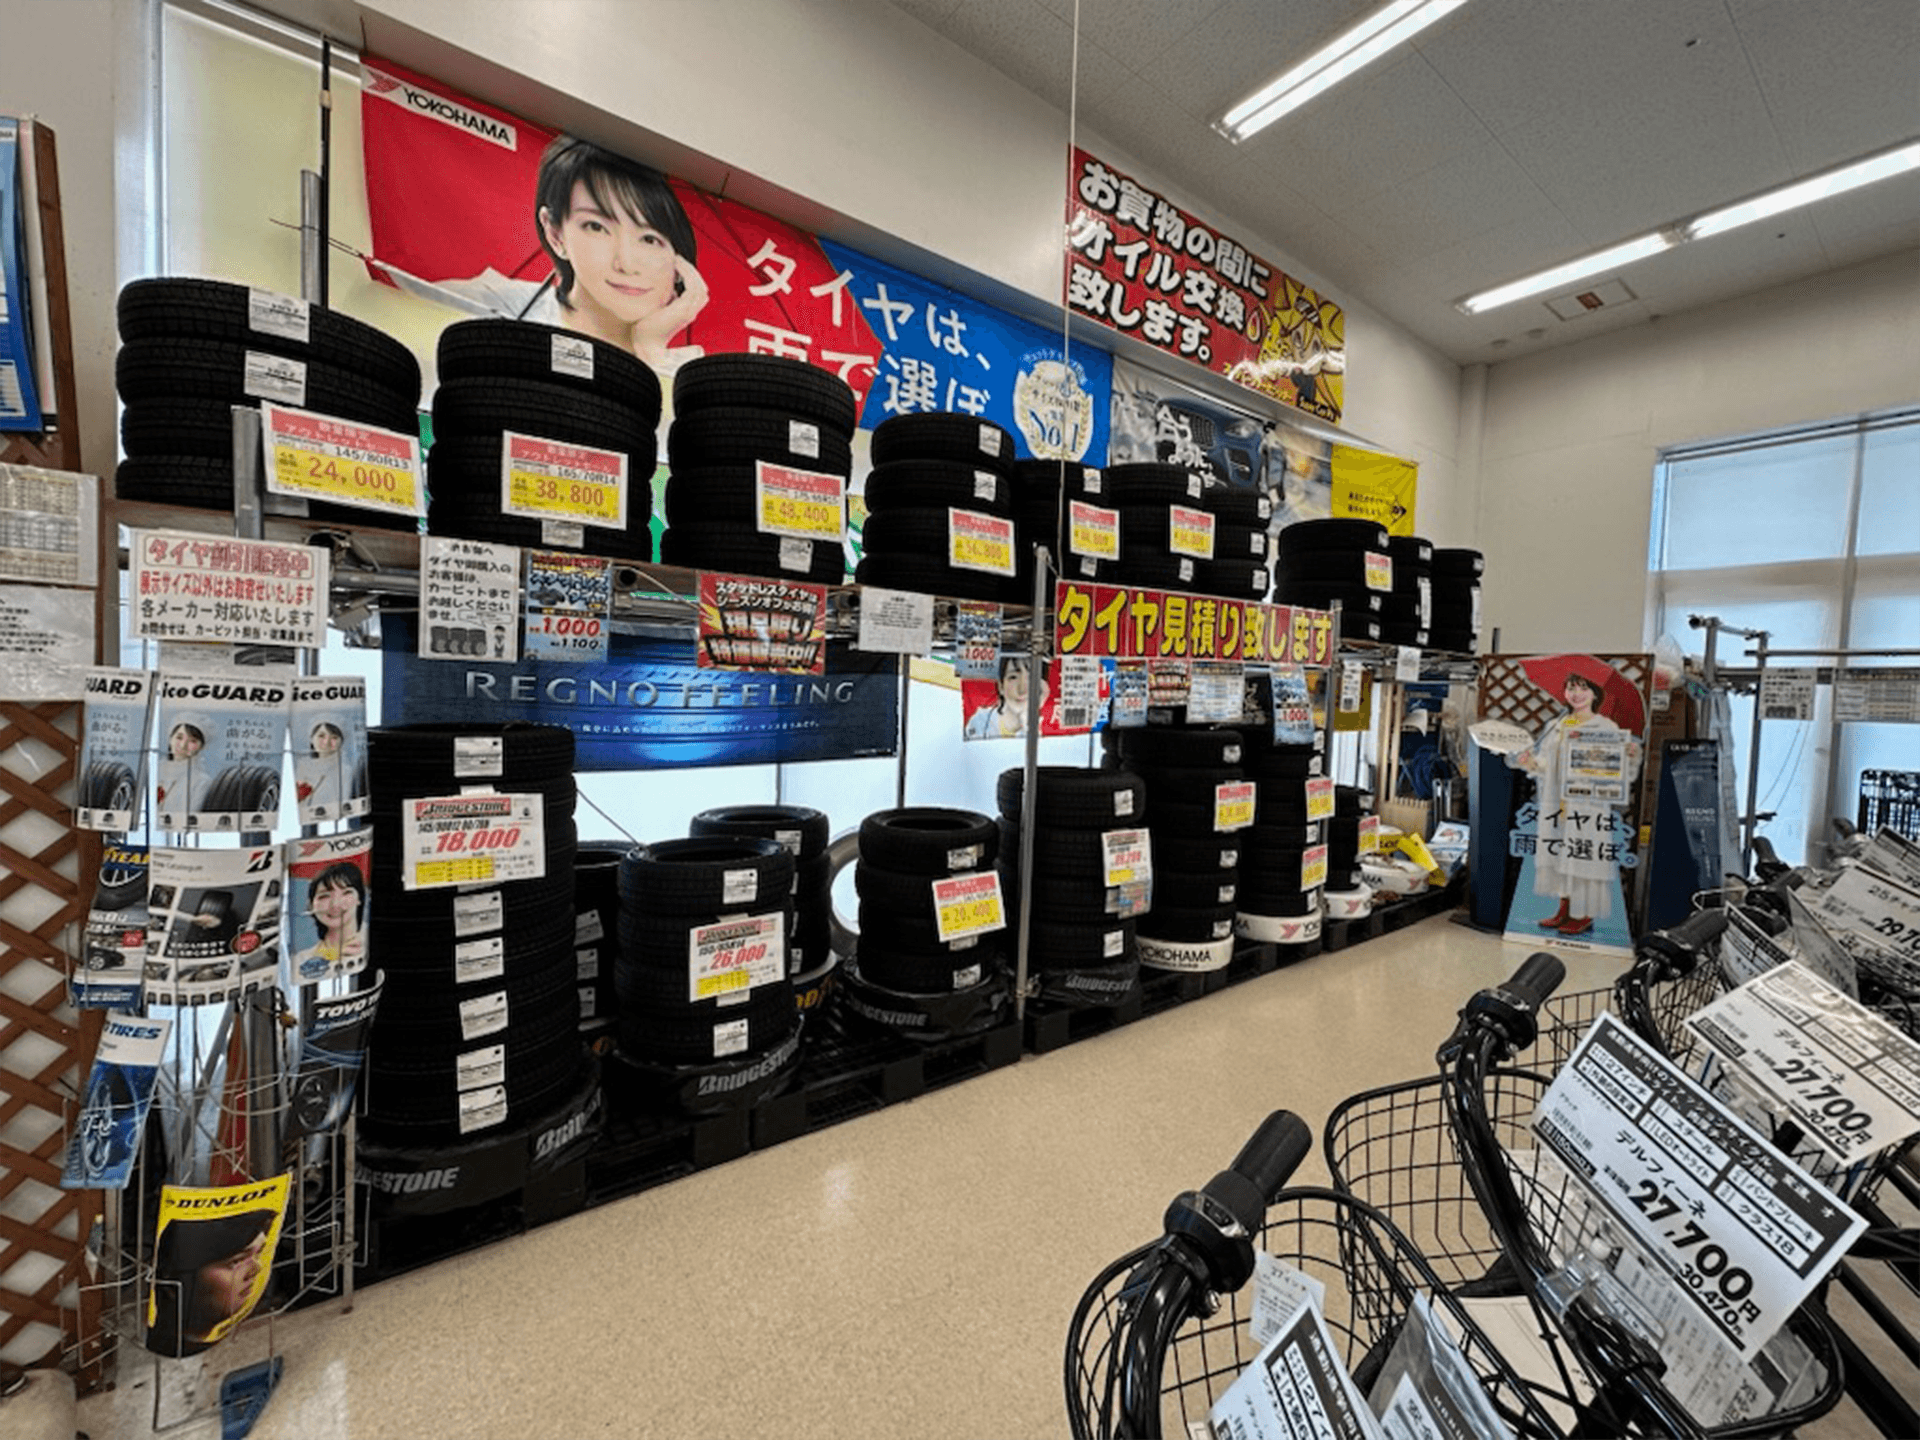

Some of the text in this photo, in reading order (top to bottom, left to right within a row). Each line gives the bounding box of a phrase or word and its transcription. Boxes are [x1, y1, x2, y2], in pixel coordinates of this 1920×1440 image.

[402, 87, 512, 145] YOKOHAMA
[1078, 161, 1270, 298] お買物の間に
[1069, 209, 1248, 331] オイル交換
[747, 238, 991, 371] タイヤは、
[1068, 262, 1211, 362] 致します。
[308, 455, 397, 492] 24,000
[535, 479, 605, 507] 38,800
[140, 598, 315, 627] 各メーカー対応いたします
[1058, 583, 1333, 664] タイヤ見積り致します
[465, 671, 855, 709] REGNO FEELING
[1519, 806, 1635, 835] タイヤは、
[436, 827, 521, 853] 18,000
[1513, 834, 1638, 866] 雨で選ぼ。
[709, 943, 768, 970] 26,000
[316, 1001, 364, 1019] TOYO
[106, 1023, 161, 1040] TIRES
[1774, 1028, 1846, 1085] デルフィーネ
[1672, 1113, 1714, 1157] スチール
[1615, 1130, 1707, 1219] デルフィーネ
[176, 1185, 277, 1210] DUNLOP
[1738, 1202, 1796, 1256] クラス18
